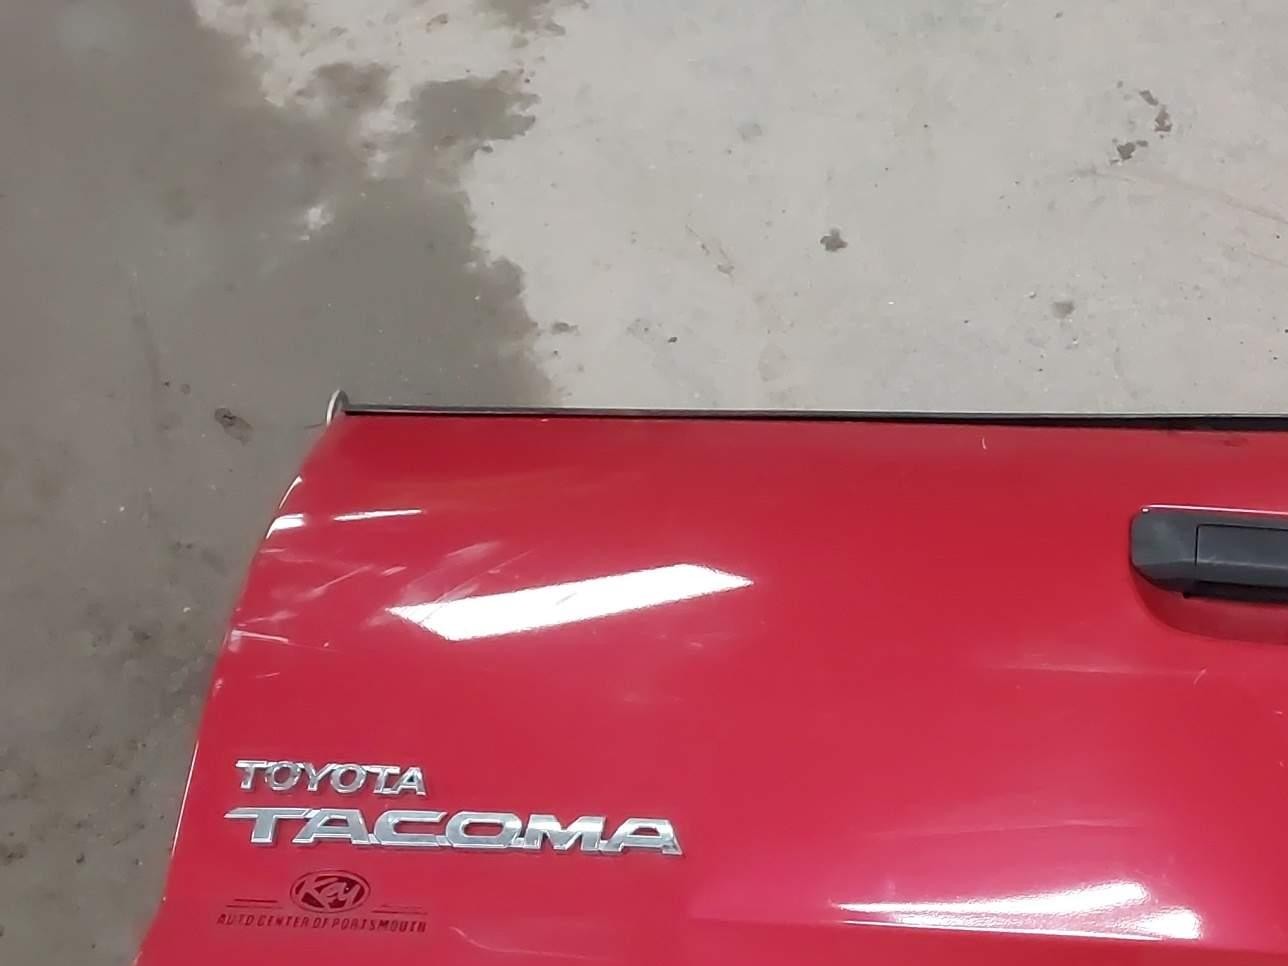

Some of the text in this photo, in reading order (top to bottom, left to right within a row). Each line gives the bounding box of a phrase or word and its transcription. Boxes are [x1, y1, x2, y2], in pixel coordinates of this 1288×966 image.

[235, 760, 427, 796] TOYOTA
[224, 807, 684, 856] TACOMA
[216, 913, 428, 934] AUTO CENTER OF PORTSMOUTH
